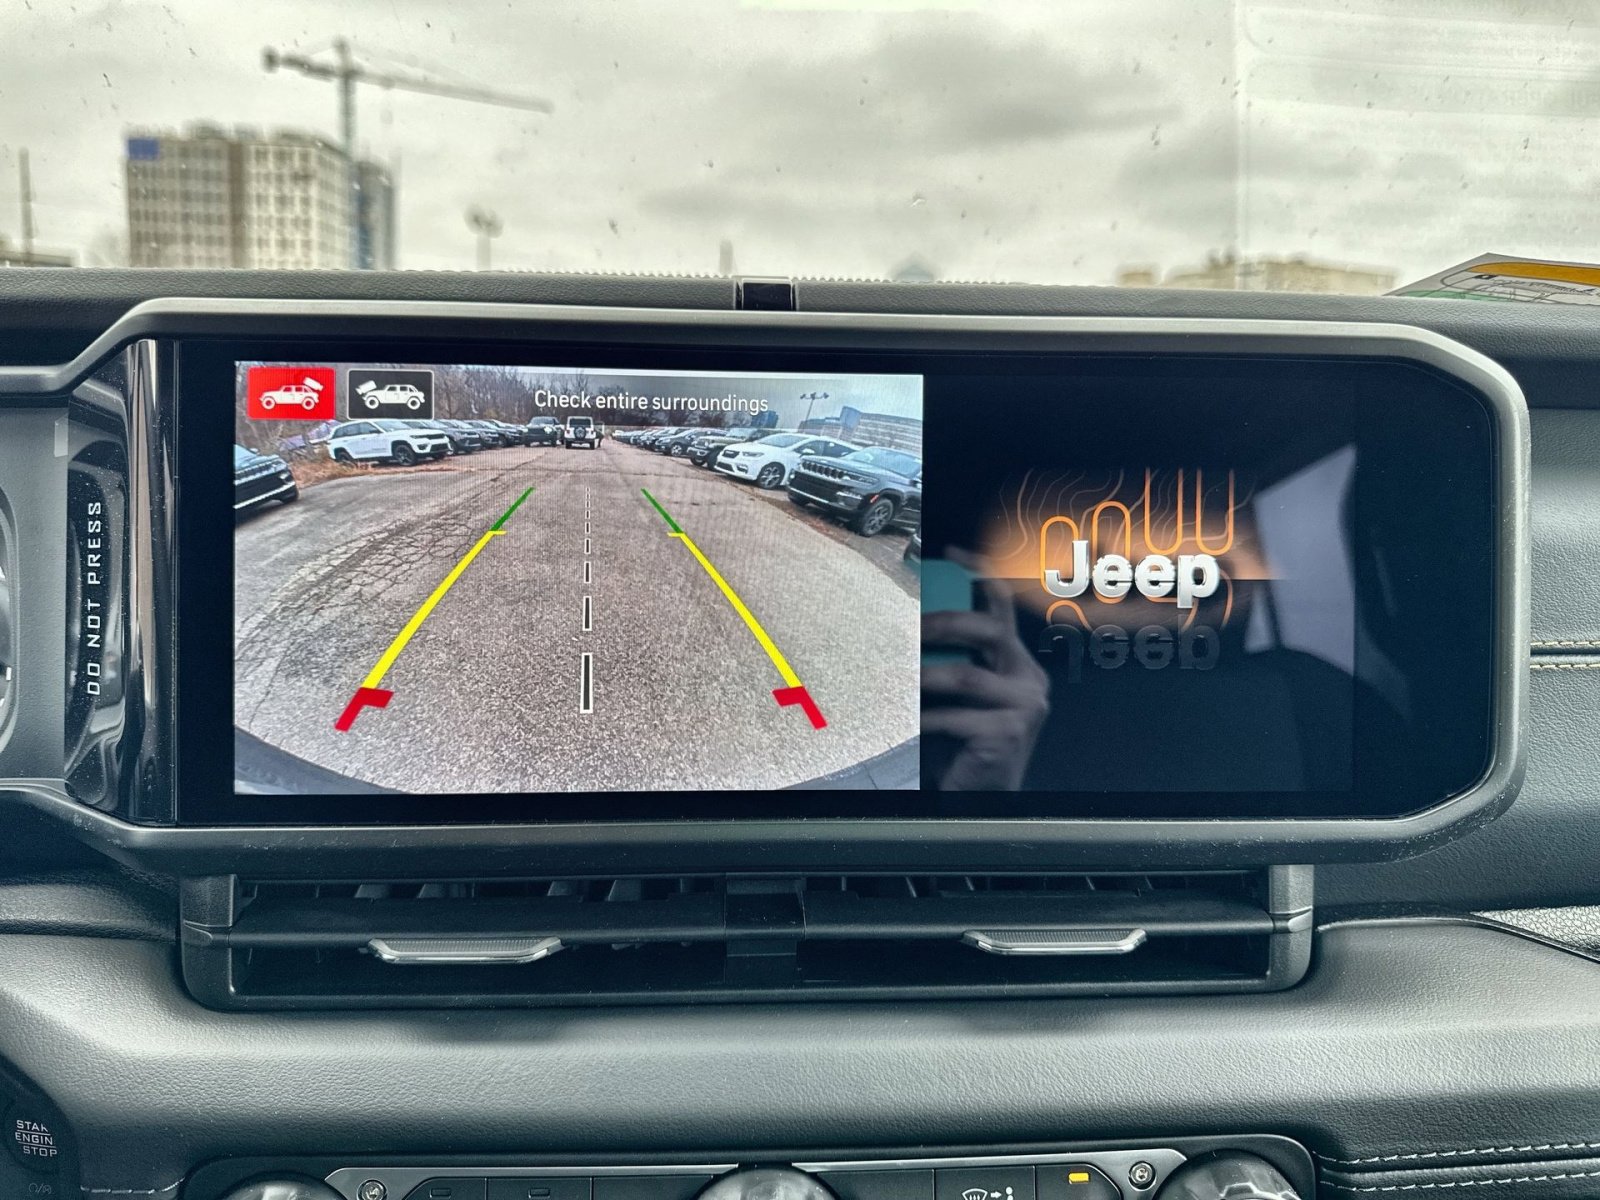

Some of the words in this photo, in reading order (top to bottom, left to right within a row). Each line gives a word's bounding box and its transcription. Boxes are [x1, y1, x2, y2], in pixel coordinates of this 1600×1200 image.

[534, 389, 592, 409] Check
[595, 391, 648, 410] entire
[652, 394, 769, 415] surroundings
[87, 502, 101, 584] PRESS
[1044, 540, 1221, 609] Jeep
[87, 598, 101, 647] NOT
[87, 662, 101, 696] DO
[23, 1145, 57, 1157] STOP
